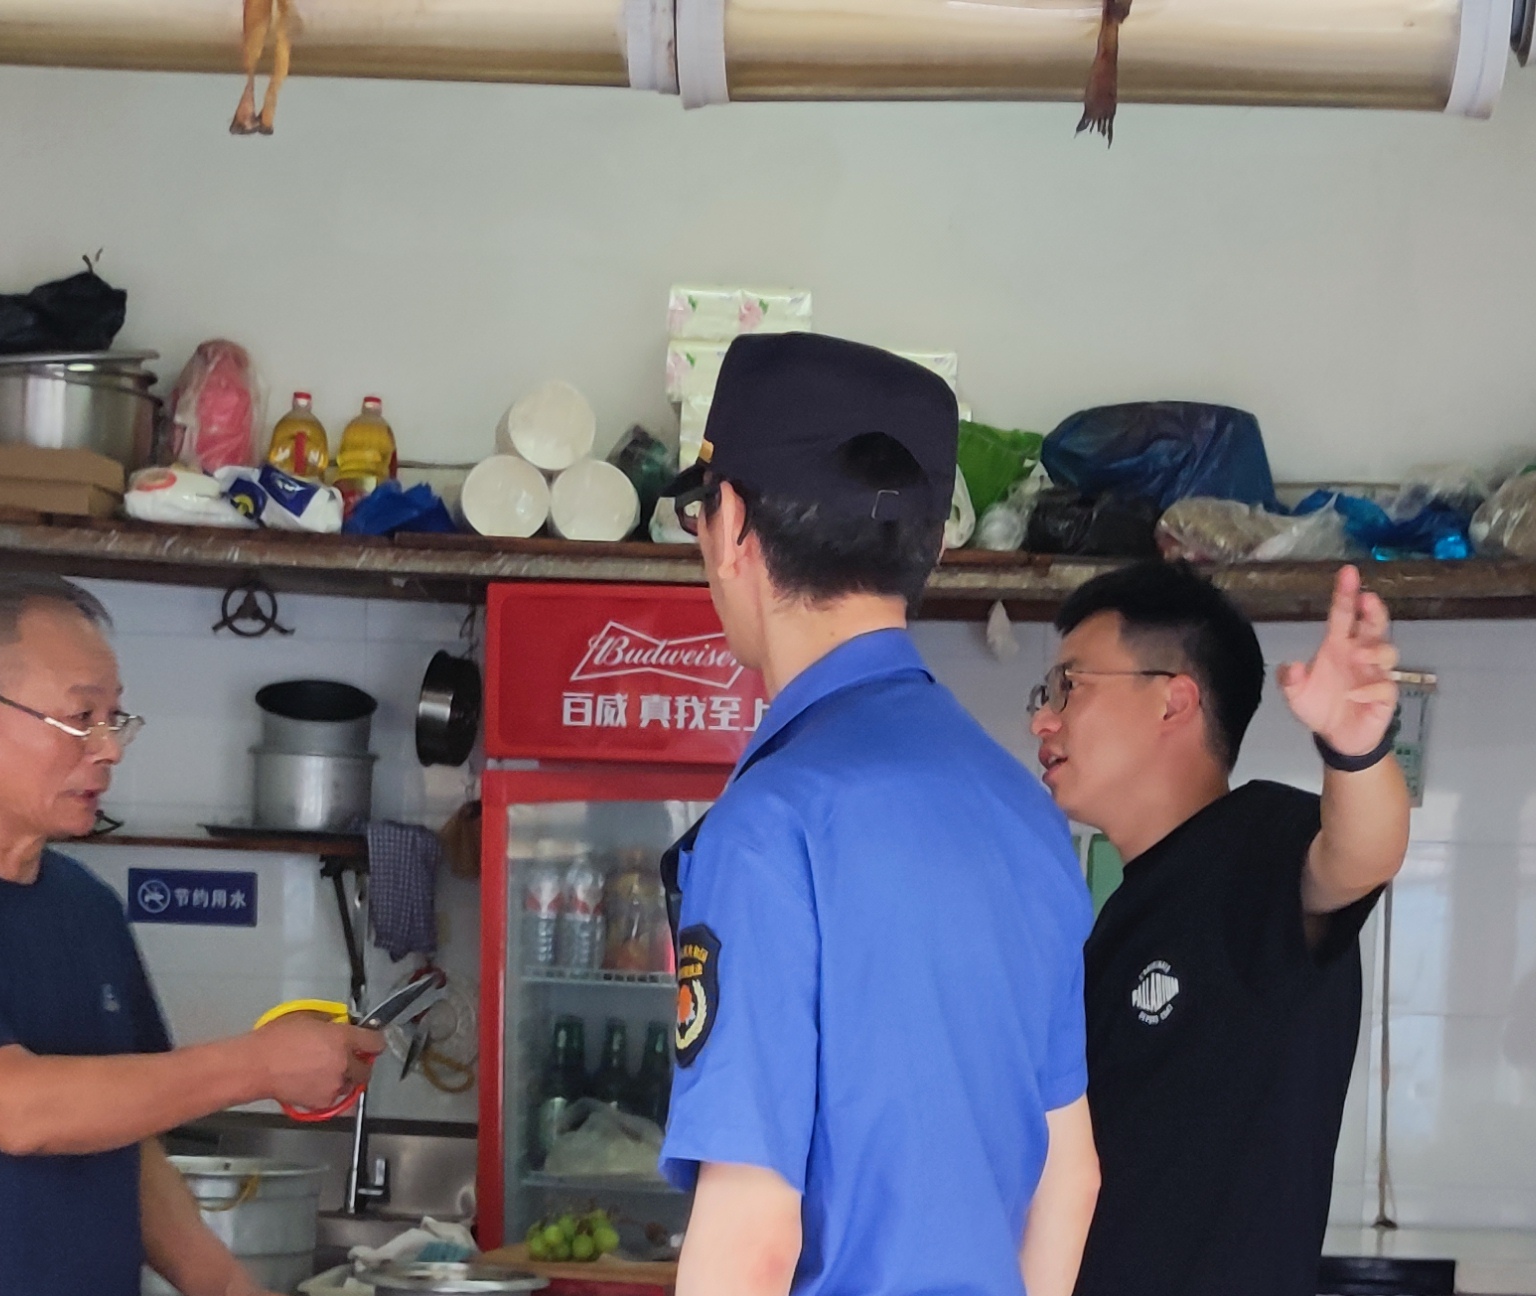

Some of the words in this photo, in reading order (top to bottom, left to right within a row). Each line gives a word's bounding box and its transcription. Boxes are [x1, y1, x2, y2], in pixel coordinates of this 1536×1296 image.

[562, 692, 628, 728] 百威
[174, 887, 247, 909] 节约用水
